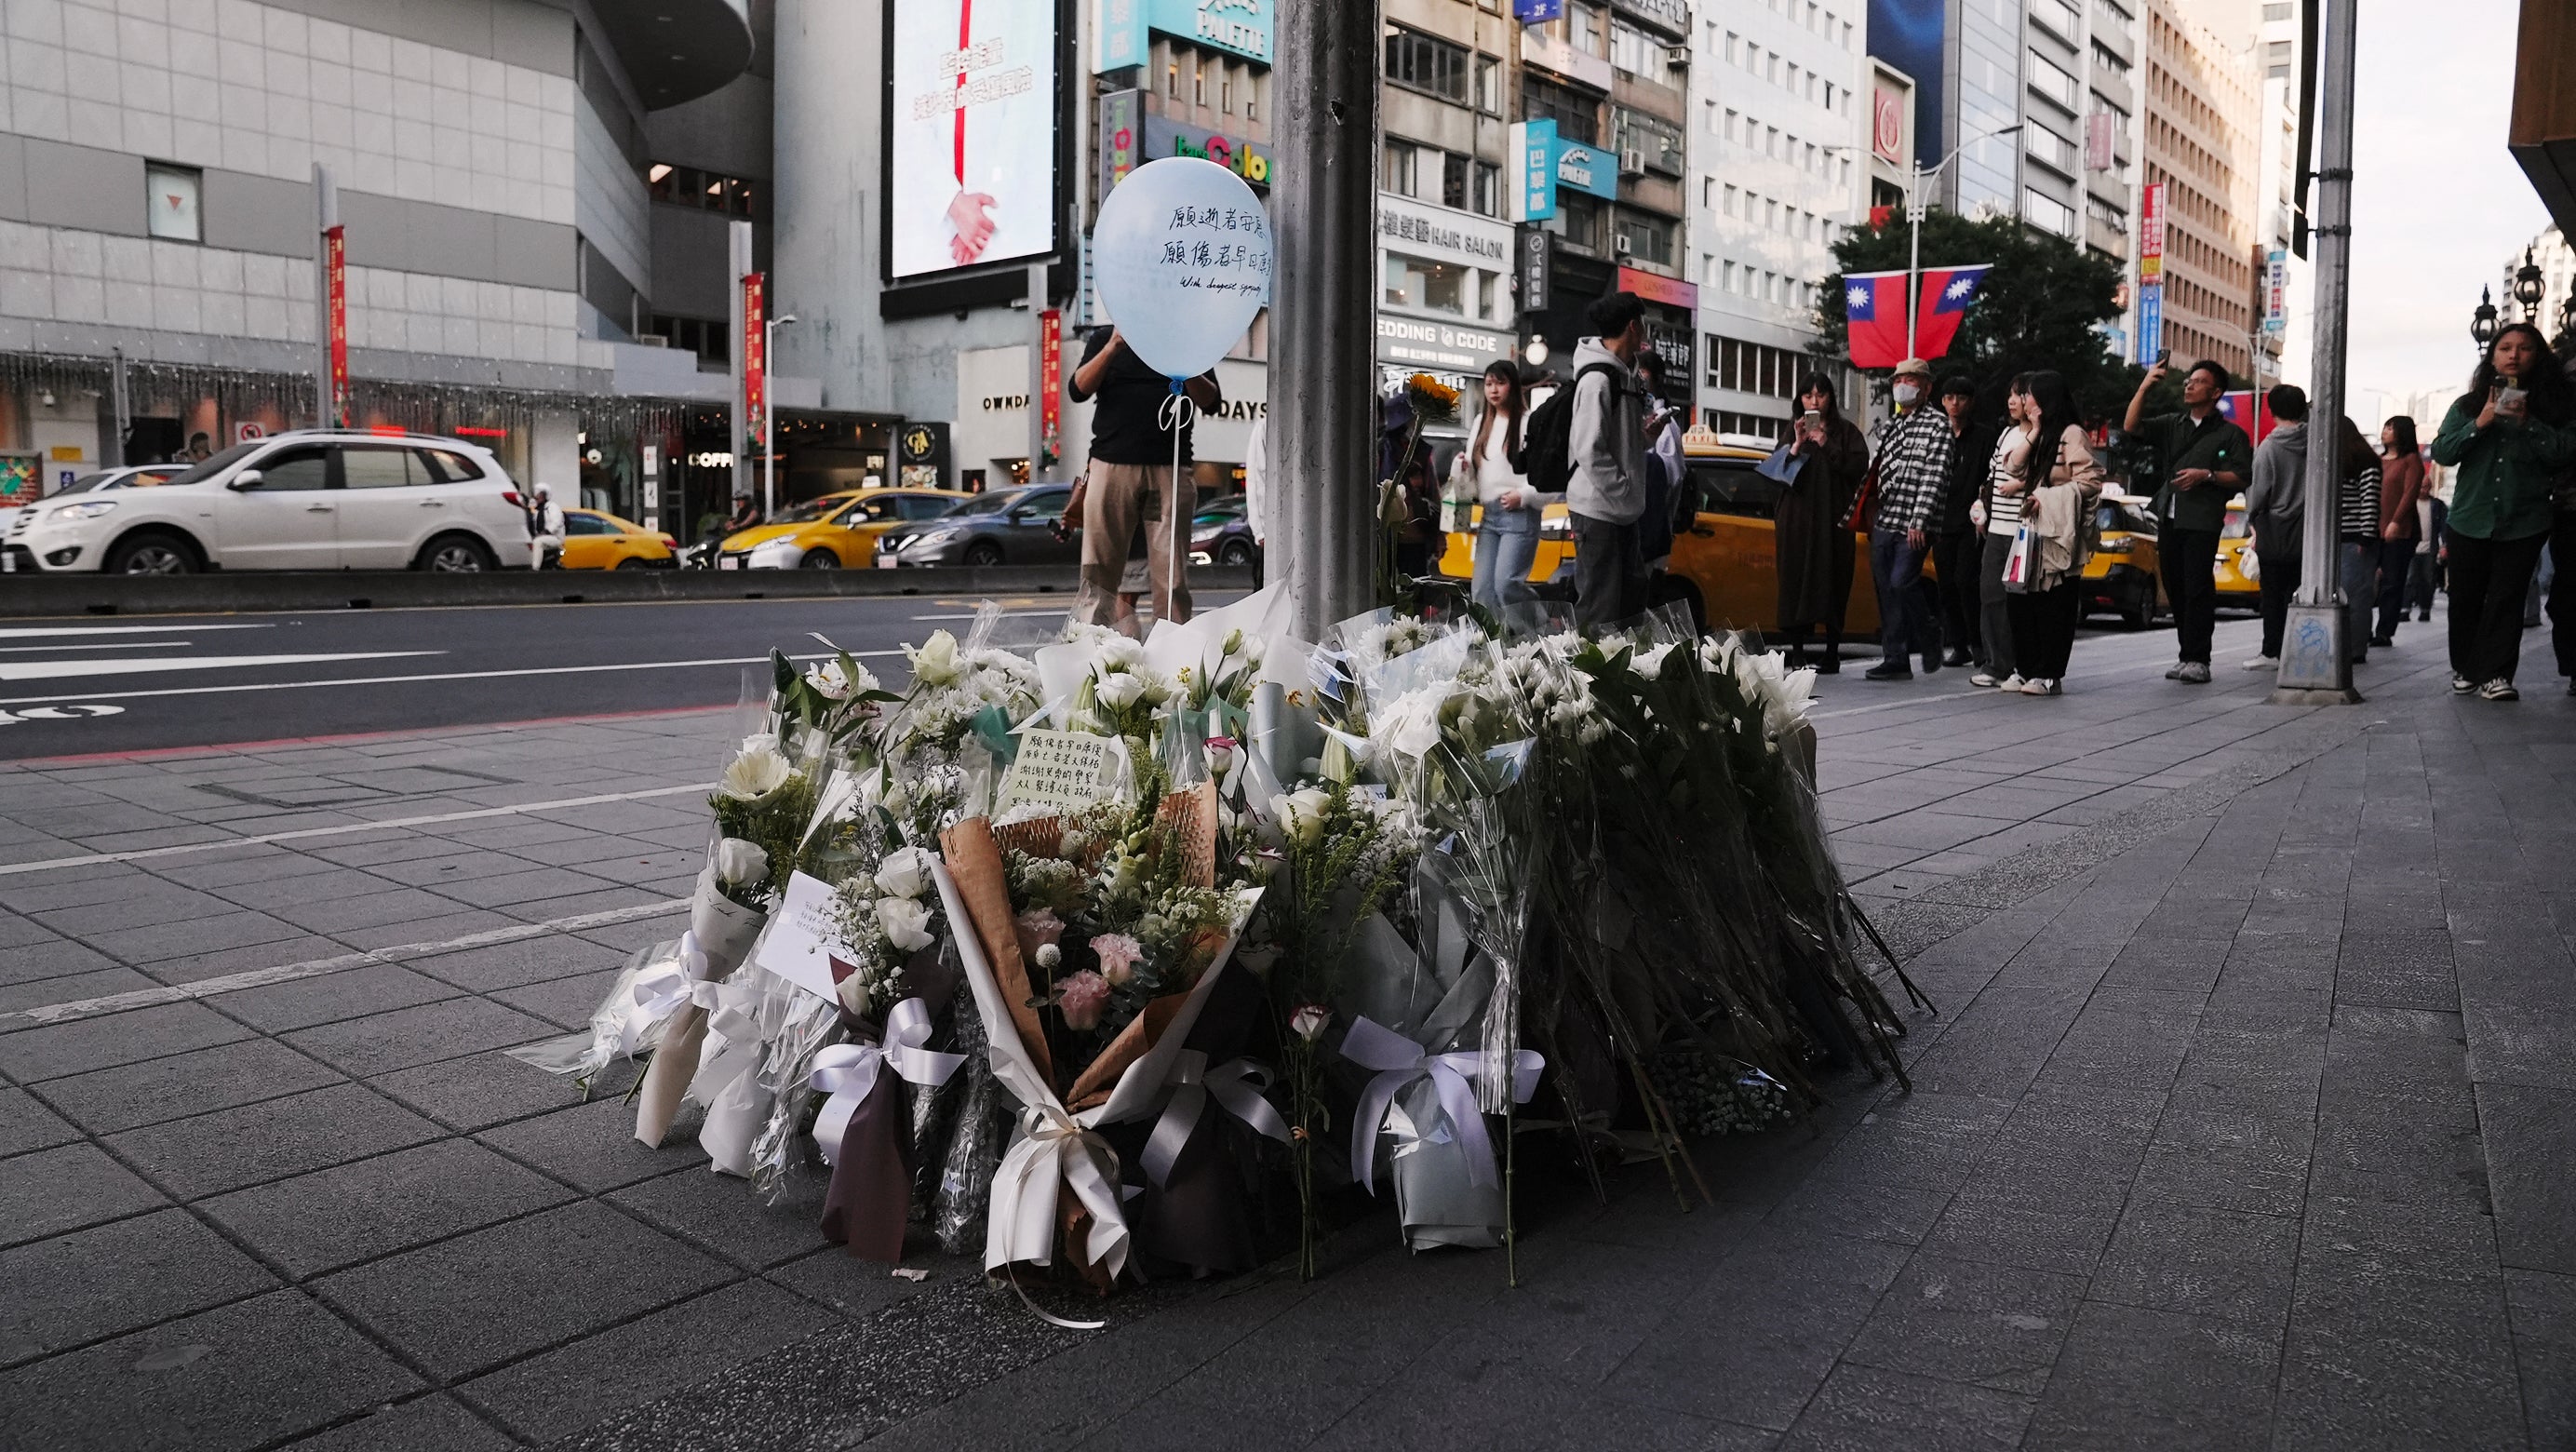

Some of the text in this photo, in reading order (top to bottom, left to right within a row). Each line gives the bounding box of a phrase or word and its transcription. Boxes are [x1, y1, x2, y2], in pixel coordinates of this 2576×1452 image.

[1197, 11, 1264, 57] PALETTE
[1431, 226, 1461, 250] HAIR
[1464, 235, 1504, 260] SALON
[1377, 319, 1497, 353] EDDING CODE
